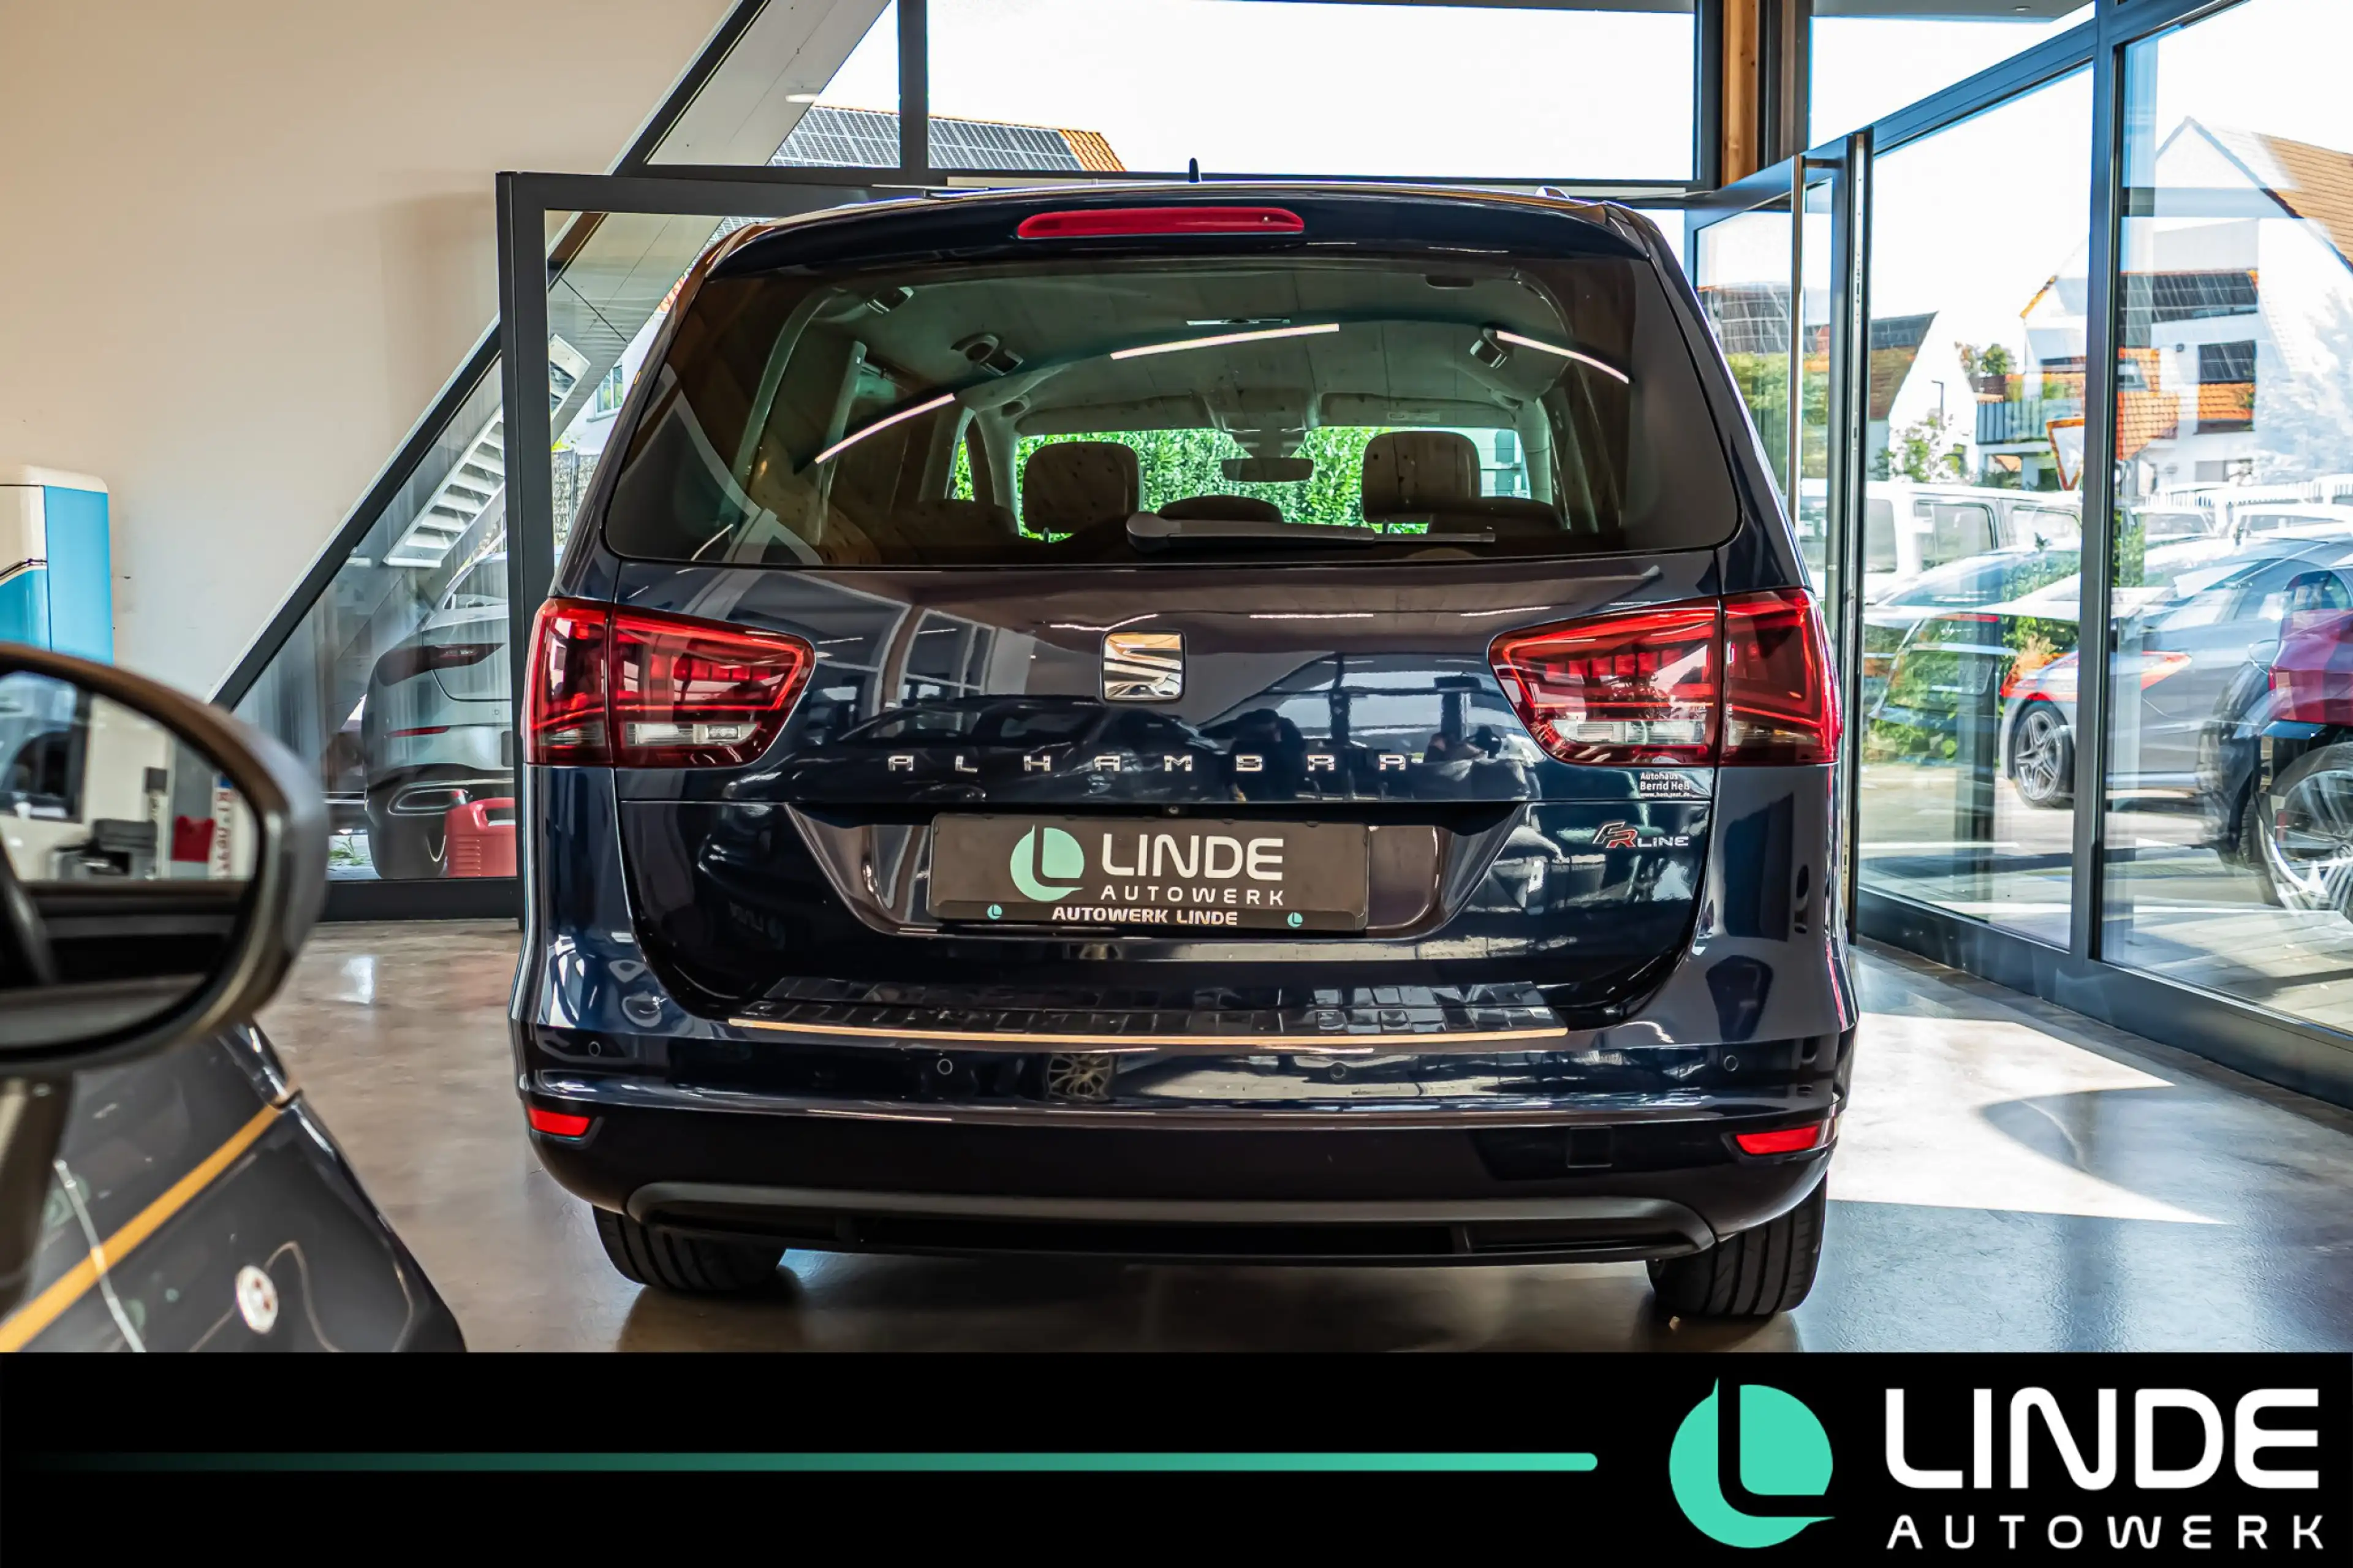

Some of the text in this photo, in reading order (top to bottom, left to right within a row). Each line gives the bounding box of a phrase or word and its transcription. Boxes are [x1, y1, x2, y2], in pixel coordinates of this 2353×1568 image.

[888, 754, 1406, 773] ALHAMBRA
[1640, 781, 1669, 790] Bernd
[1102, 833, 1284, 881] LINDE
[1101, 884, 1284, 906] AUTOWERK
[1051, 906, 1238, 926] AUTOWERK LINDE
